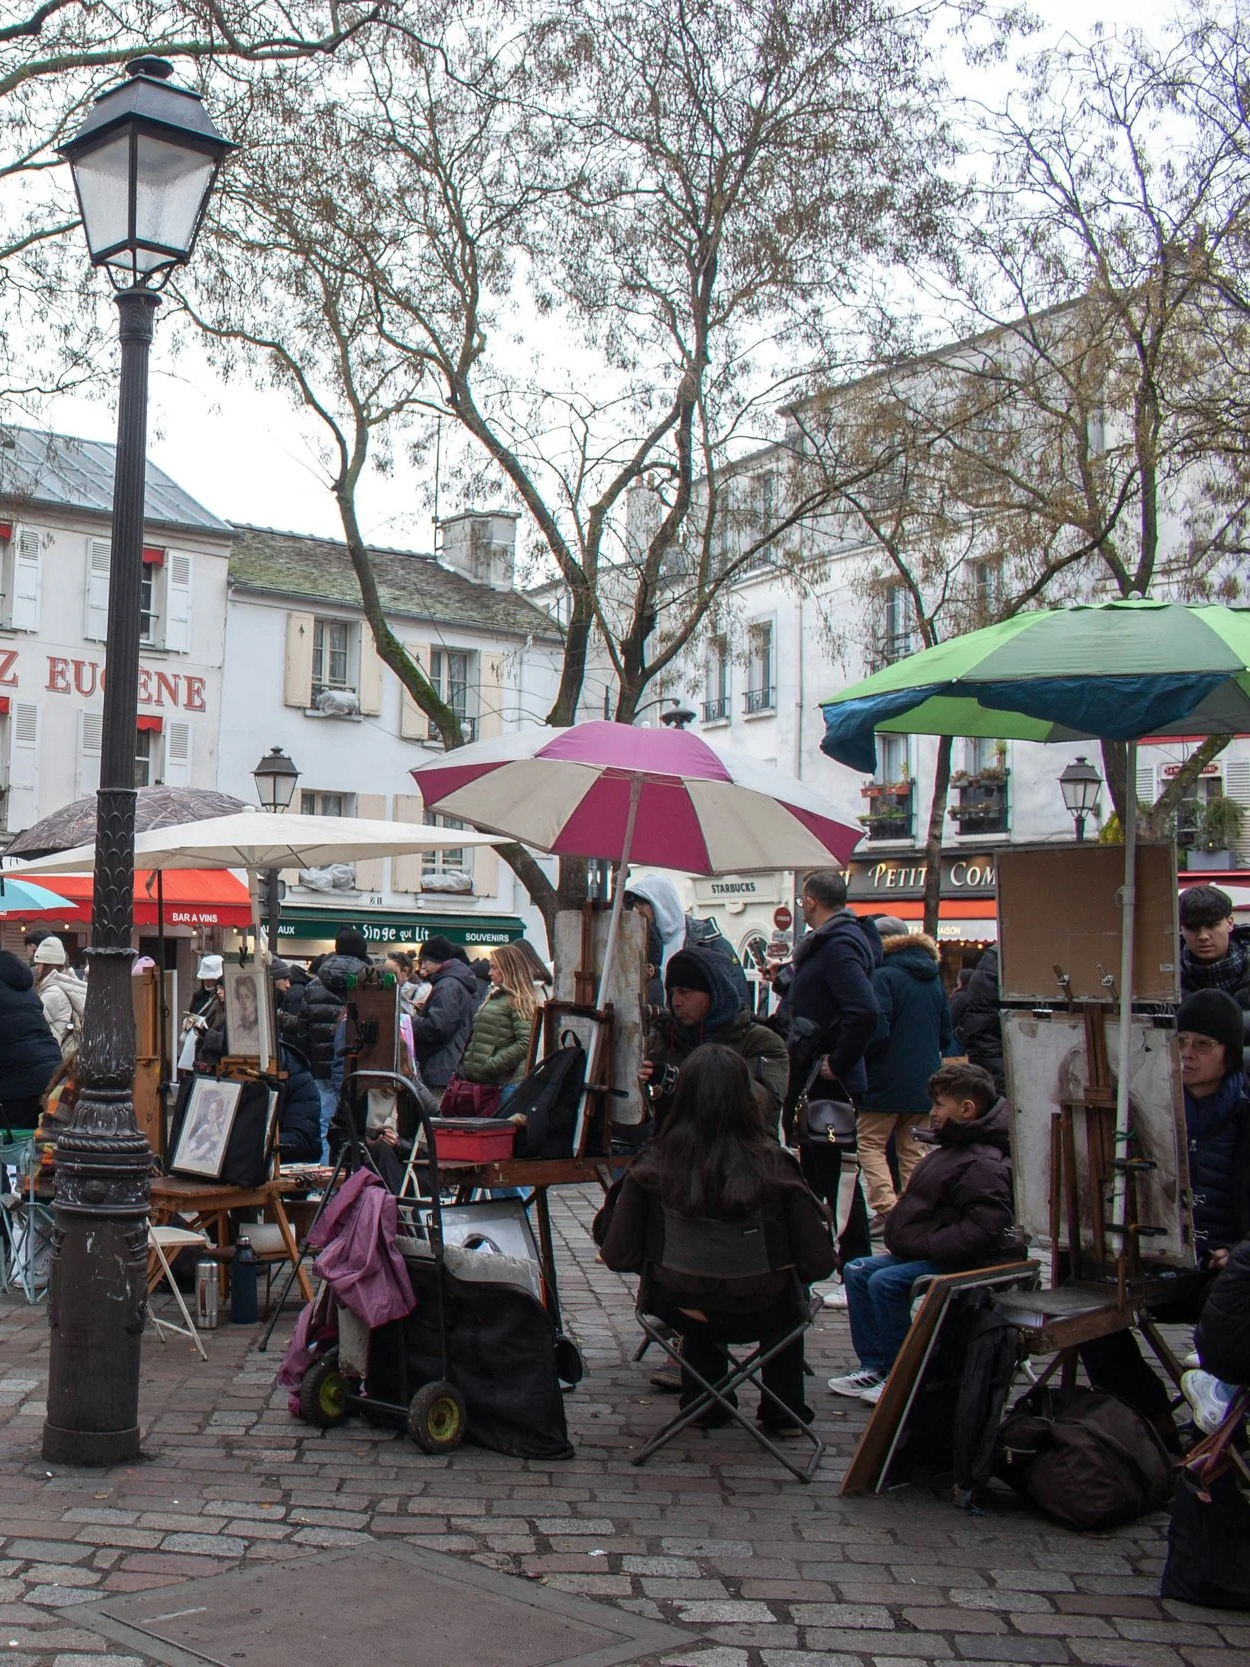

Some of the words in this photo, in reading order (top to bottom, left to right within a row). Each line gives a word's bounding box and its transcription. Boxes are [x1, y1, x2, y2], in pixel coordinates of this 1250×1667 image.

[44, 655, 207, 713] EUÈNE
[867, 863, 928, 888] PETIT
[950, 862, 996, 887] COM
[711, 882, 756, 894] STARBUCKS
[172, 912, 190, 922] BAR
[191, 913, 198, 922] A
[199, 913, 218, 923] VINS
[362, 924, 396, 941] Singe
[399, 928, 412, 941] qui
[415, 926, 430, 942] Lit
[465, 932, 510, 943] SOUVENIRS
